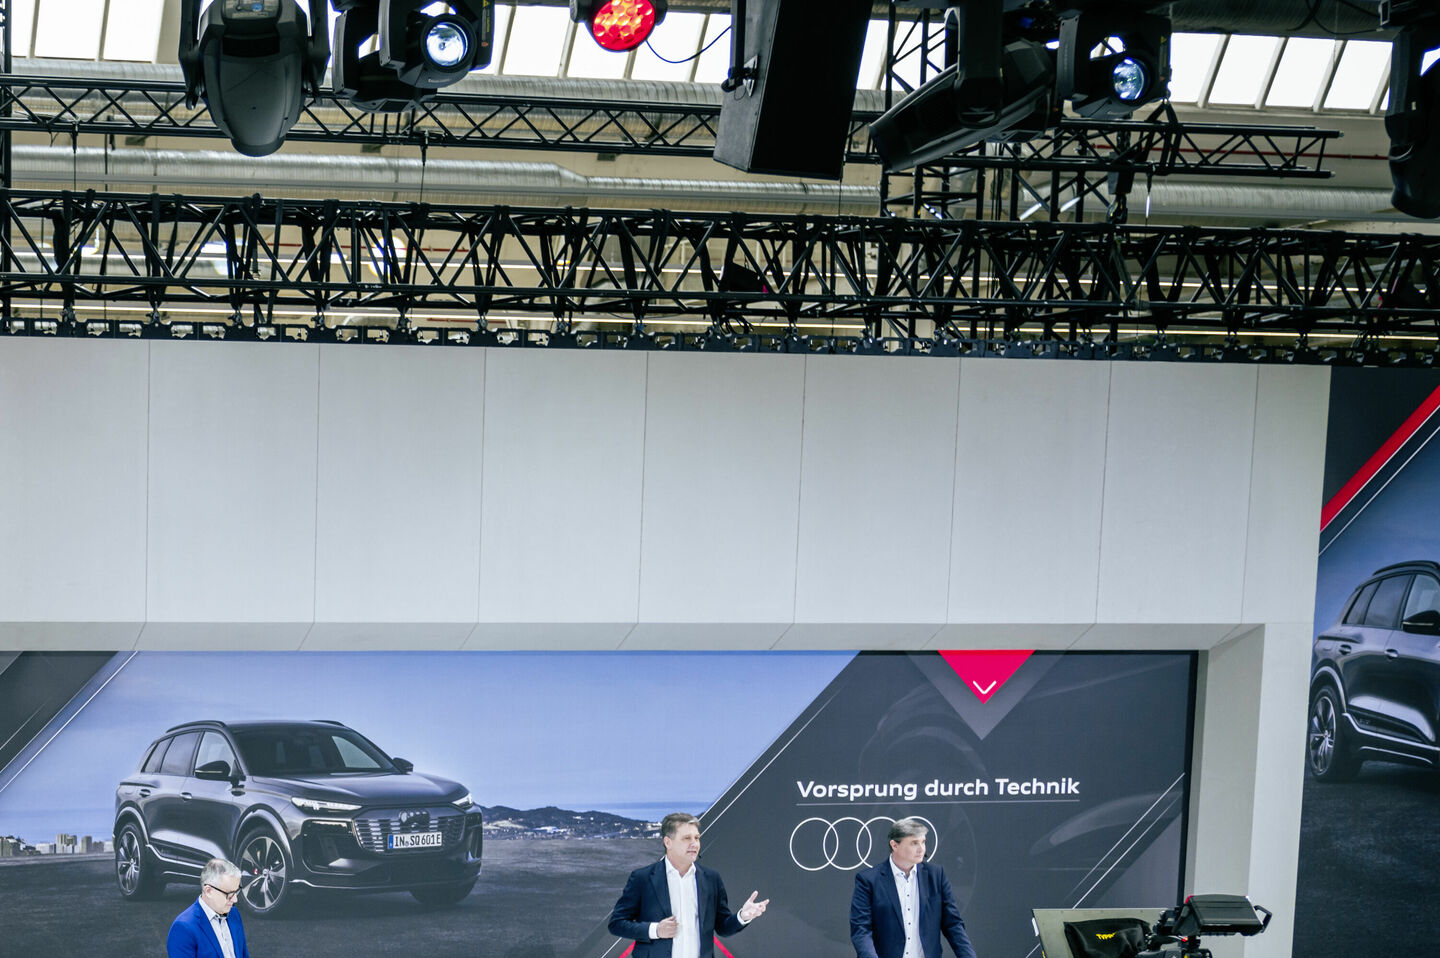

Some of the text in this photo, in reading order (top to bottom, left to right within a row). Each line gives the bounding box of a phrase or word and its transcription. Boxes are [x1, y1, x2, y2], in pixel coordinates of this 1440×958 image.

[796, 778, 1080, 801] Vorsprung durch Technik
[395, 836, 405, 847] IN
